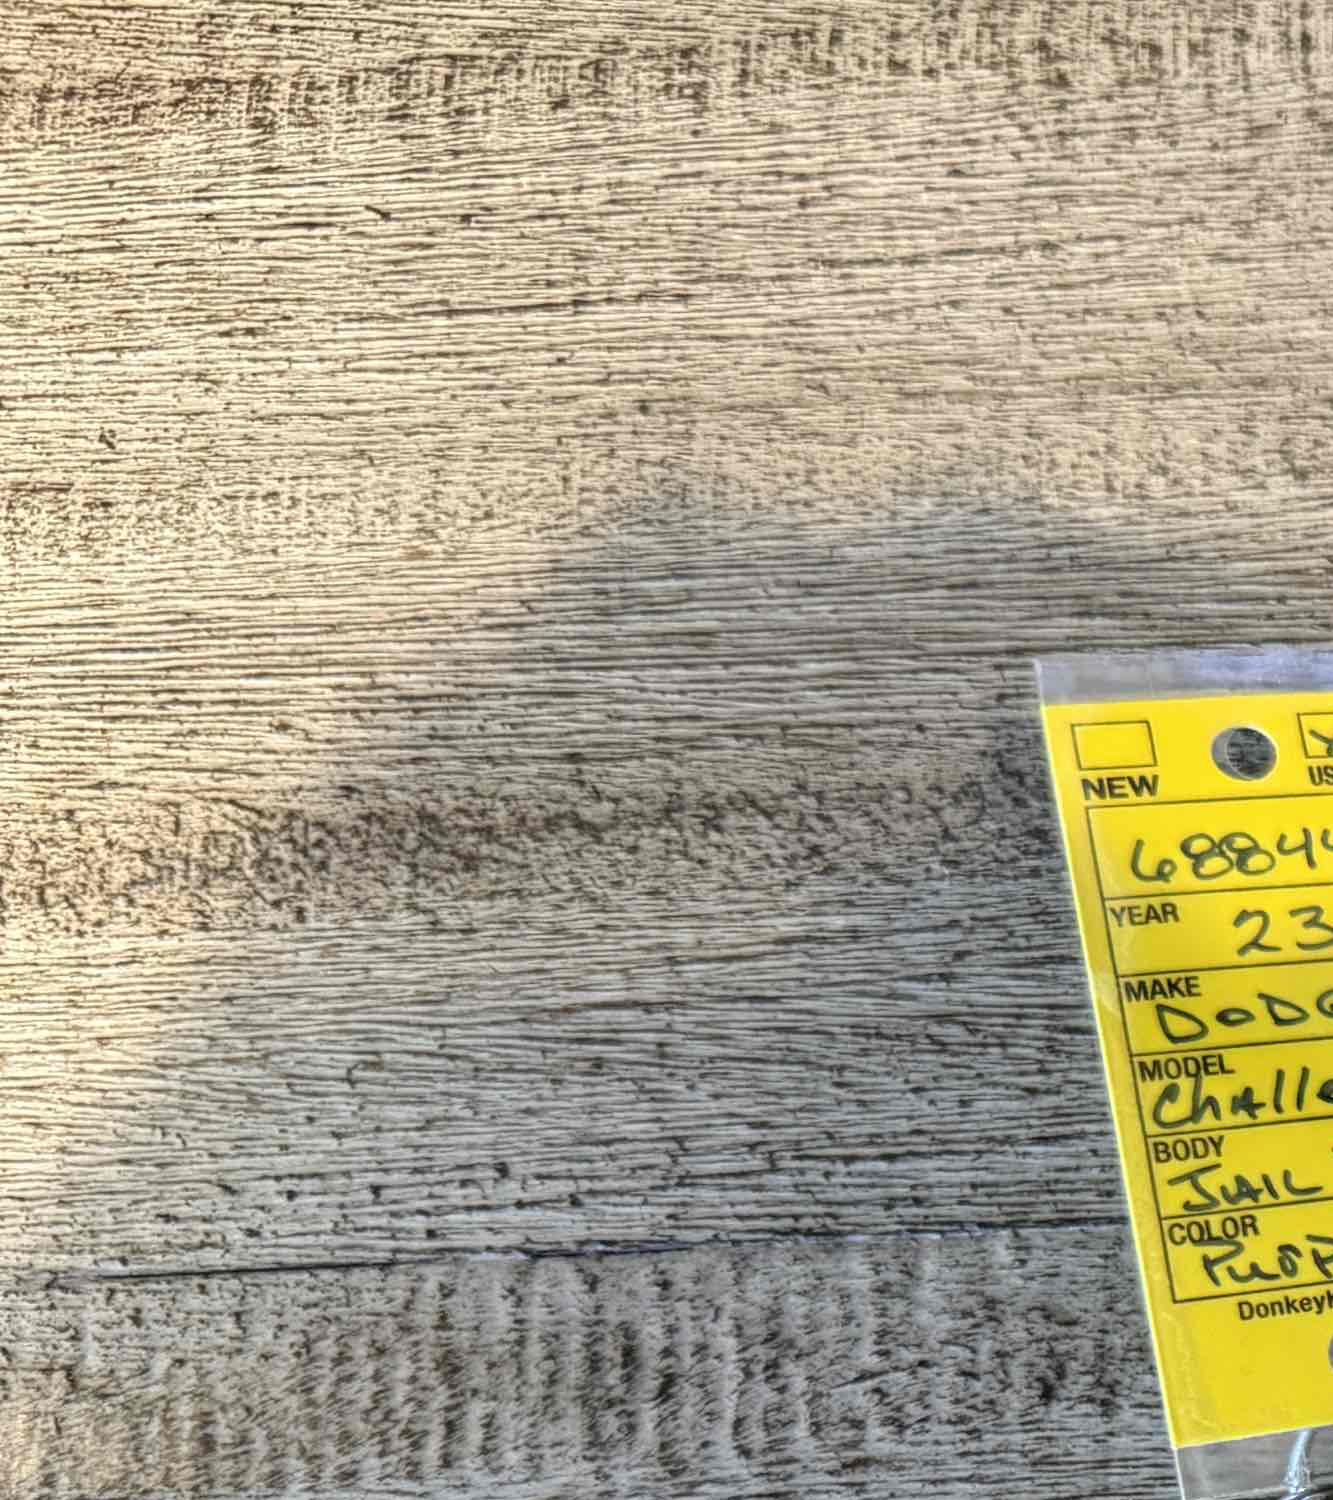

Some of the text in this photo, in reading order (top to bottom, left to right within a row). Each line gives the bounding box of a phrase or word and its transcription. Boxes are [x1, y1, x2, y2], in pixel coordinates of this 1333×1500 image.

[1081, 774, 1160, 800] NEW
[1110, 901, 1180, 928] YEAR
[1124, 976, 1202, 1002] MAKE
[1138, 1053, 1236, 1083] MODEL
[1153, 1135, 1226, 1164] BODY
[1167, 1214, 1260, 1246] COLOR
